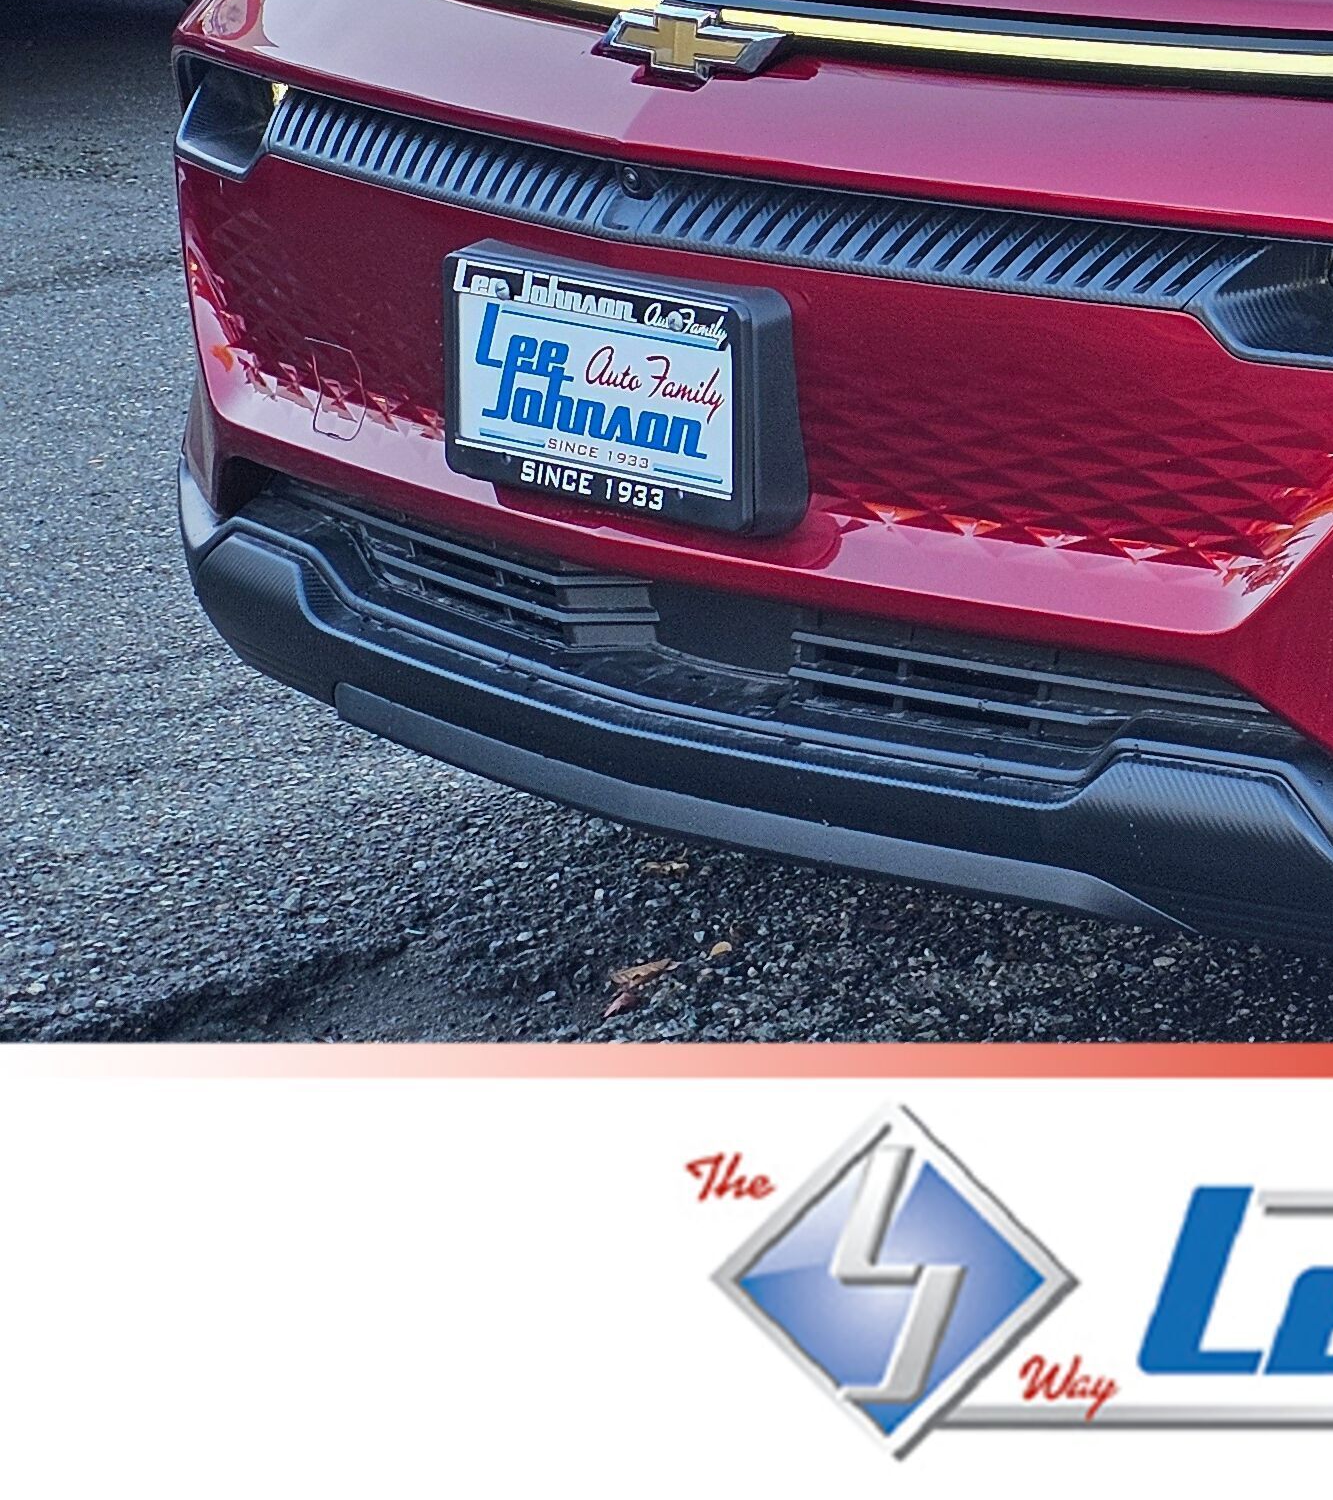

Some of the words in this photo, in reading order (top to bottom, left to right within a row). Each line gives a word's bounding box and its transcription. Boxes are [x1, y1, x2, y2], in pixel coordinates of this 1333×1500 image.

[476, 302, 570, 377] Lee
[514, 270, 637, 323] Johnson
[644, 303, 680, 331] Au
[679, 308, 729, 350] Family
[482, 360, 707, 460] Johnson
[585, 346, 642, 391] Auto
[646, 355, 726, 425] Family
[520, 461, 594, 496] SINCE
[605, 478, 664, 511] 1933
[547, 438, 599, 458] SINCE
[608, 450, 650, 469] 1933
